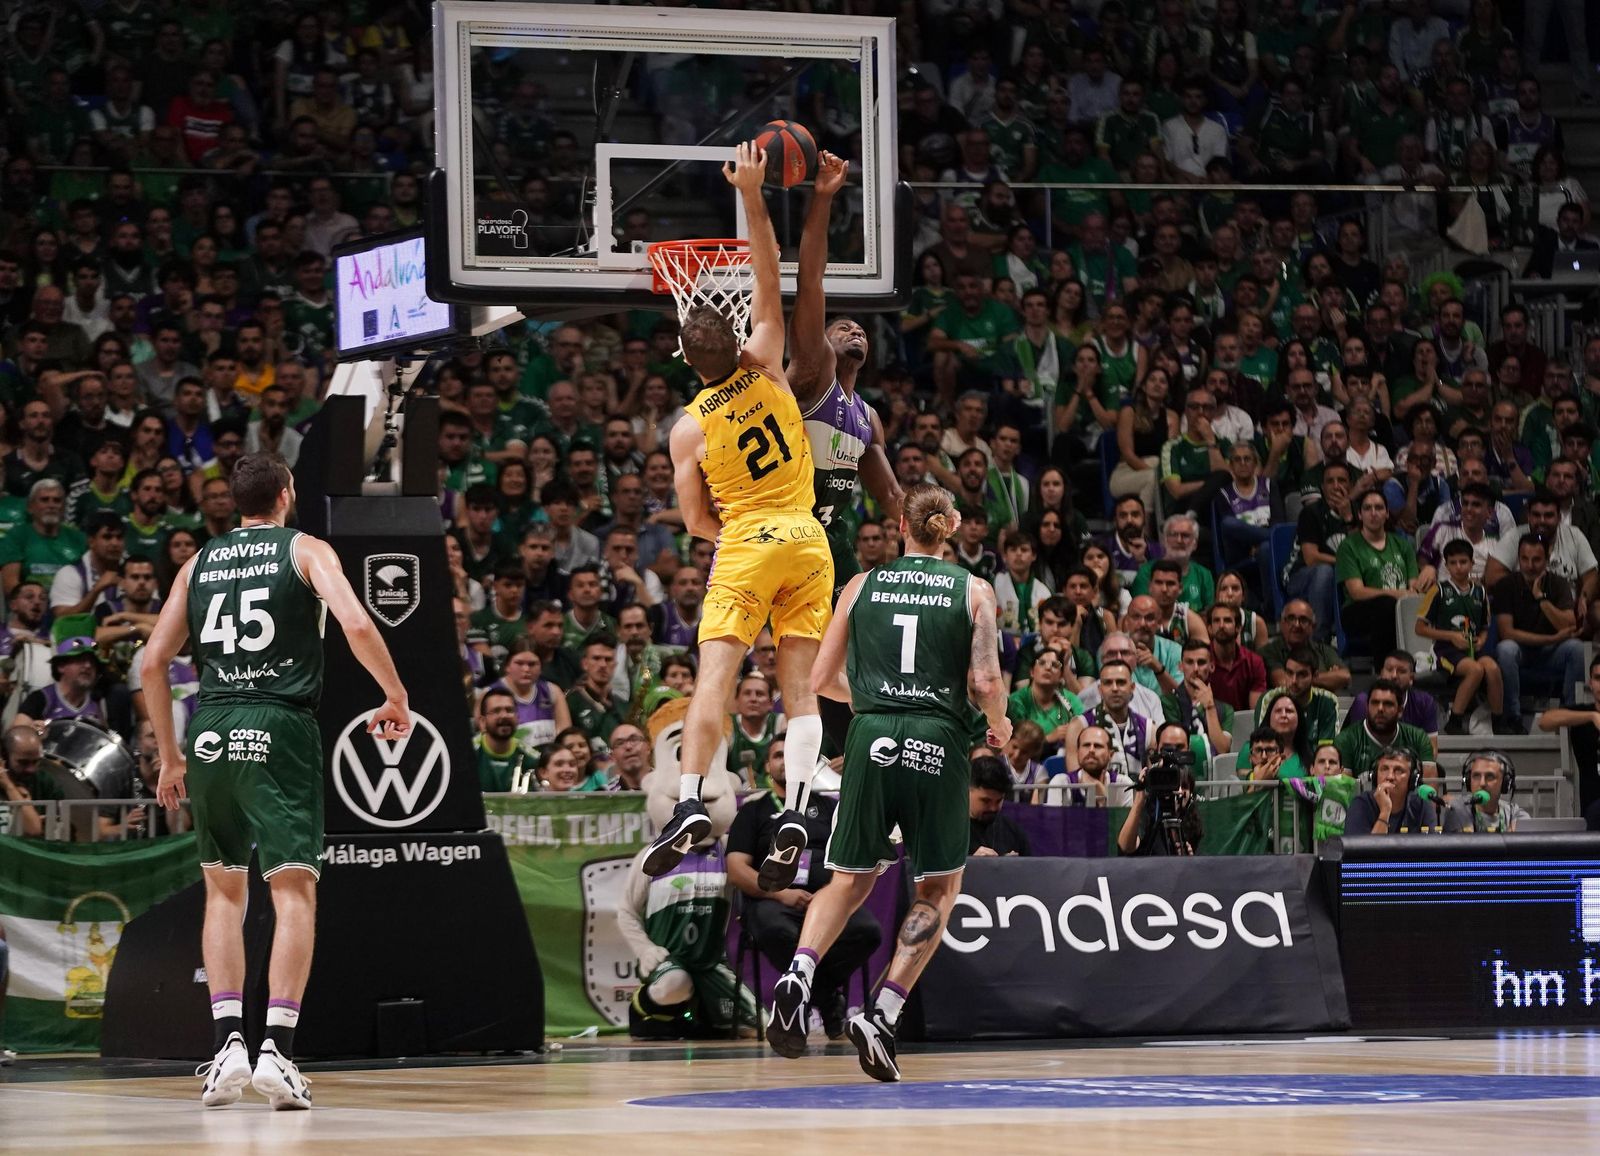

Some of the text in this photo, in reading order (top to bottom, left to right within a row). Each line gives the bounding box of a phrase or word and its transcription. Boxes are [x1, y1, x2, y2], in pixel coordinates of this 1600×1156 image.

[478, 225, 522, 235] PLAYOFF
[737, 412, 793, 482] 21
[207, 542, 278, 563] KRAVISH
[199, 562, 279, 583] BENAHAVÍS
[876, 570, 955, 590] OSETKOWSKI
[376, 588, 408, 598] Unicaja
[871, 591, 952, 608] BENAHAVÍS
[200, 587, 276, 655] 45
[892, 613, 919, 674] 1
[217, 662, 280, 683] Andalucía
[880, 680, 940, 701] Andalucía
[229, 728, 272, 744] COSTA
[228, 741, 270, 754] DEL SOL
[228, 751, 267, 763] MÁLAGA
[904, 738, 945, 758] COSTA
[901, 759, 941, 776] MÁLAGA
[902, 749, 943, 768] DEL SOL
[321, 842, 481, 868] Málaga Wagen
[941, 876, 1294, 953] endesa
[684, 921, 699, 945] 0
[1494, 960, 1565, 1008] hm
